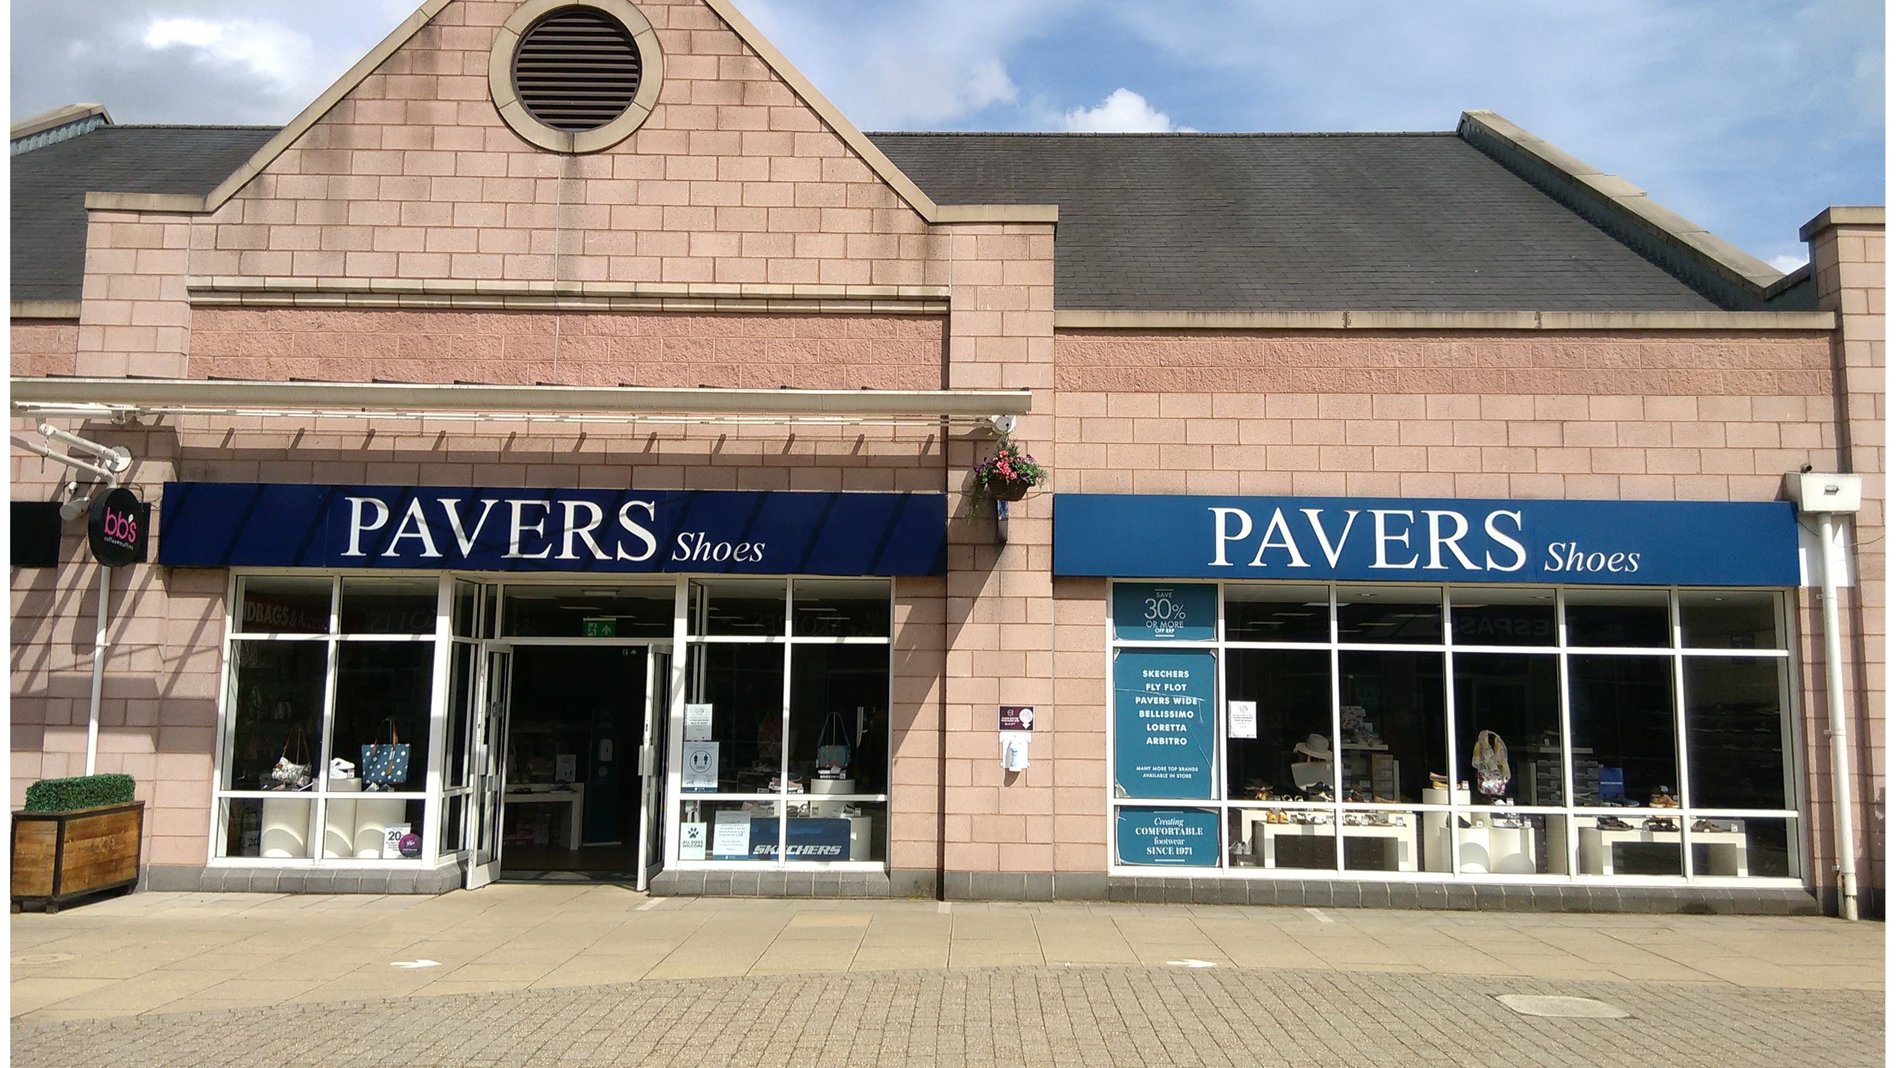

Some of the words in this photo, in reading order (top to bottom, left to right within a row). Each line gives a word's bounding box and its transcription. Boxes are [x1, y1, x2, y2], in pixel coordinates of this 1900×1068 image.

[104, 506, 138, 543] bb's
[340, 496, 658, 562] PAVERS
[672, 531, 766, 563] Shoes
[1207, 506, 1528, 572] PAVERS
[1544, 541, 1641, 573] Shoes
[1144, 598, 1187, 620] 30%
[1145, 620, 1158, 629] OR
[1160, 620, 1184, 629] MORE
[1142, 670, 1190, 679] SKECHERS
[1145, 683, 1161, 692] FLY
[1164, 683, 1187, 692] FLOT
[1135, 696, 1170, 705] PAVERS
[1173, 697, 1197, 705] WIDE
[1138, 710, 1194, 719] BELLISSIMO
[1146, 723, 1187, 732] LORETTA
[1146, 737, 1188, 746] ARBITRO
[1154, 817, 1184, 827] Creating
[388, 830, 402, 841] 20
[1135, 827, 1204, 836] COMFORTABLE
[1153, 836, 1185, 845] footwear
[752, 844, 842, 855] SKCHERS
[1146, 846, 1175, 855] SINCE
[1175, 846, 1193, 855] 1971
